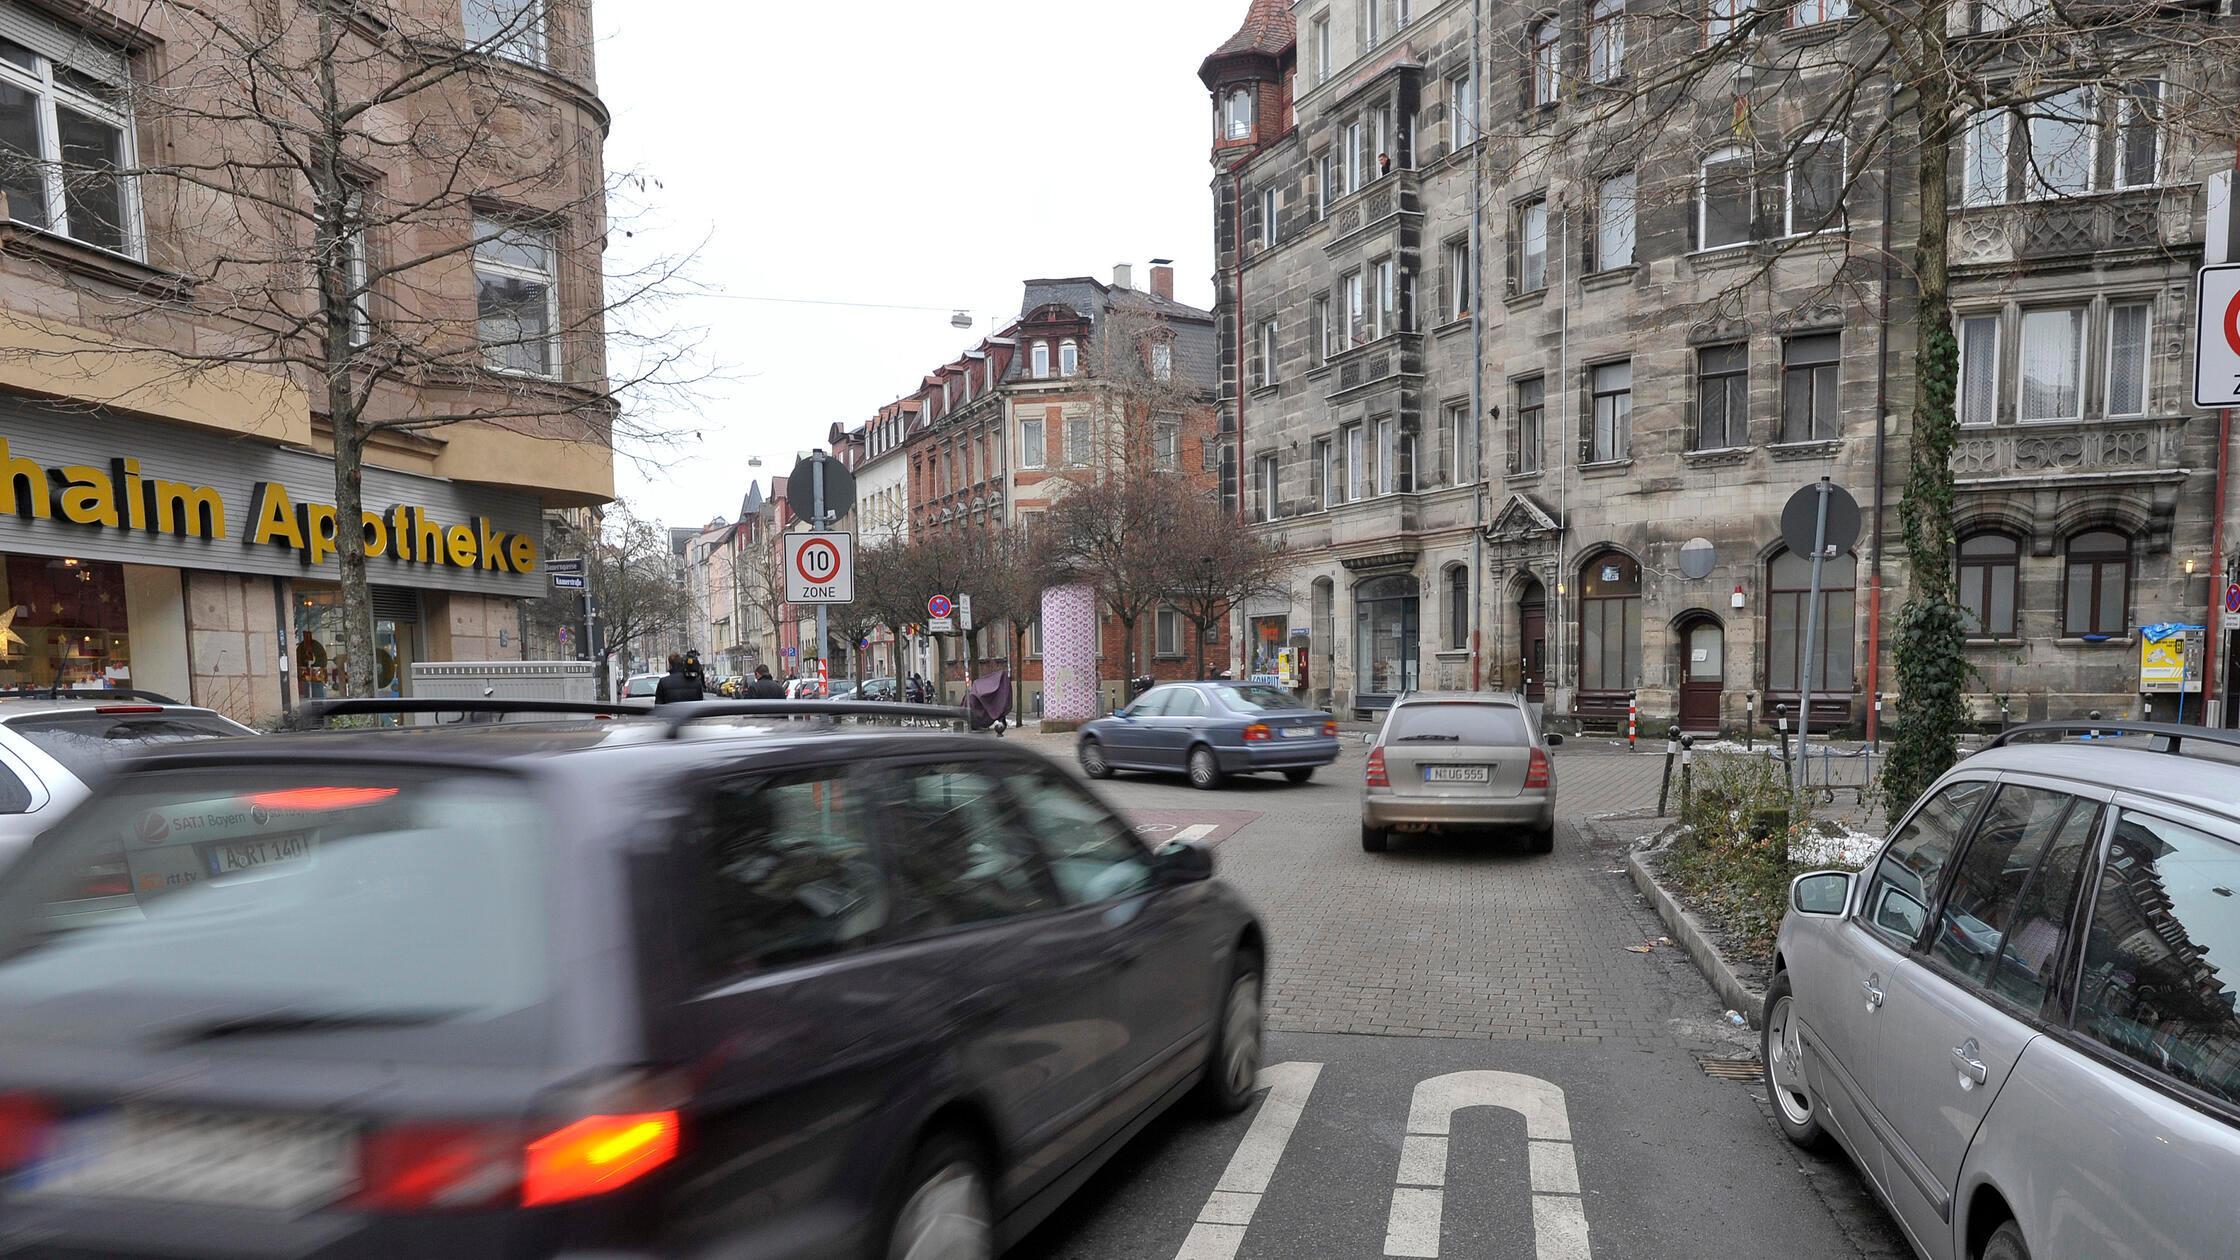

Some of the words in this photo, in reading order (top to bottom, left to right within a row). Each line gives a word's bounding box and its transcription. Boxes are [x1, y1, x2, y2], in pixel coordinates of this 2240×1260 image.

[243, 481, 538, 574] Apotheke
[807, 550, 829, 571] 10
[802, 586, 836, 598] ZONE
[1434, 768, 1443, 780] N
[1448, 768, 1463, 780] UG
[173, 815, 205, 831] SAT.1
[207, 812, 246, 827] Bayern
